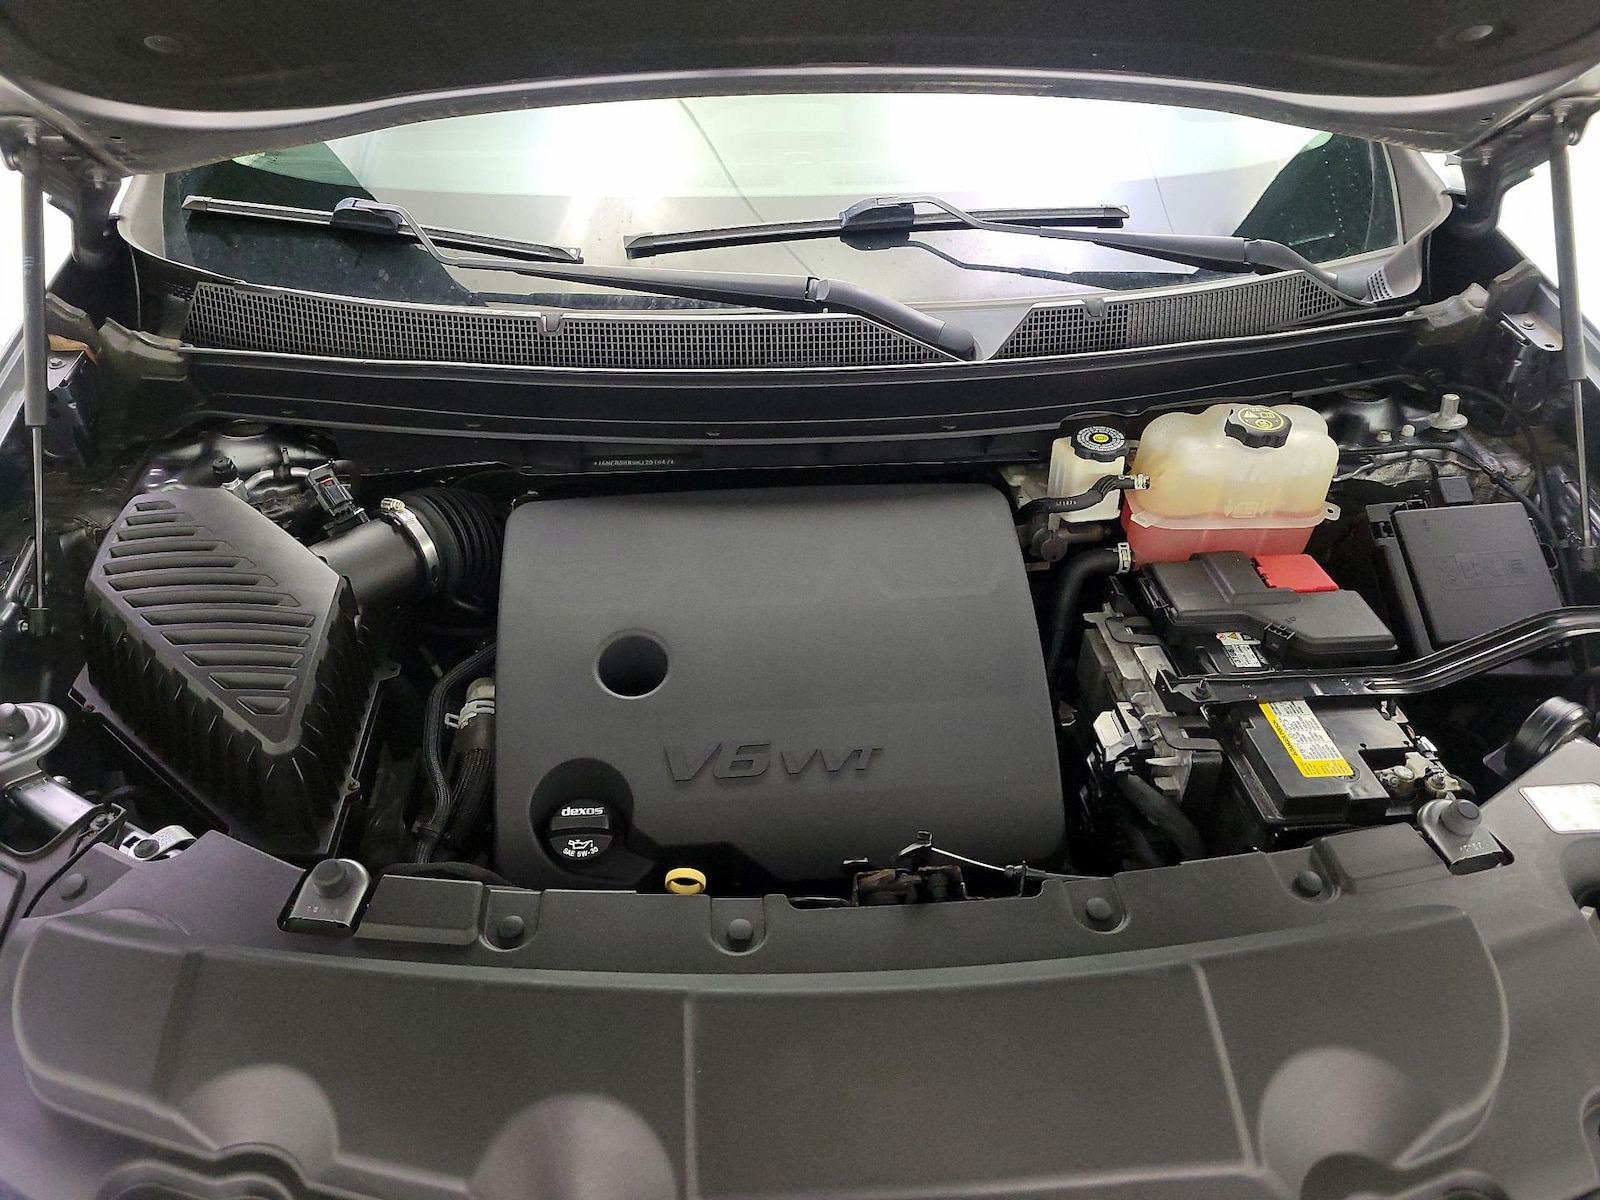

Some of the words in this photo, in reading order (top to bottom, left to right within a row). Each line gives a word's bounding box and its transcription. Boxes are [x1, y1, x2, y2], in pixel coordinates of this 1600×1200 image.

[663, 741, 772, 781] V6
[561, 806, 605, 816] dexos
[562, 847, 576, 857] SAE
[576, 846, 599, 858] 5W-30
